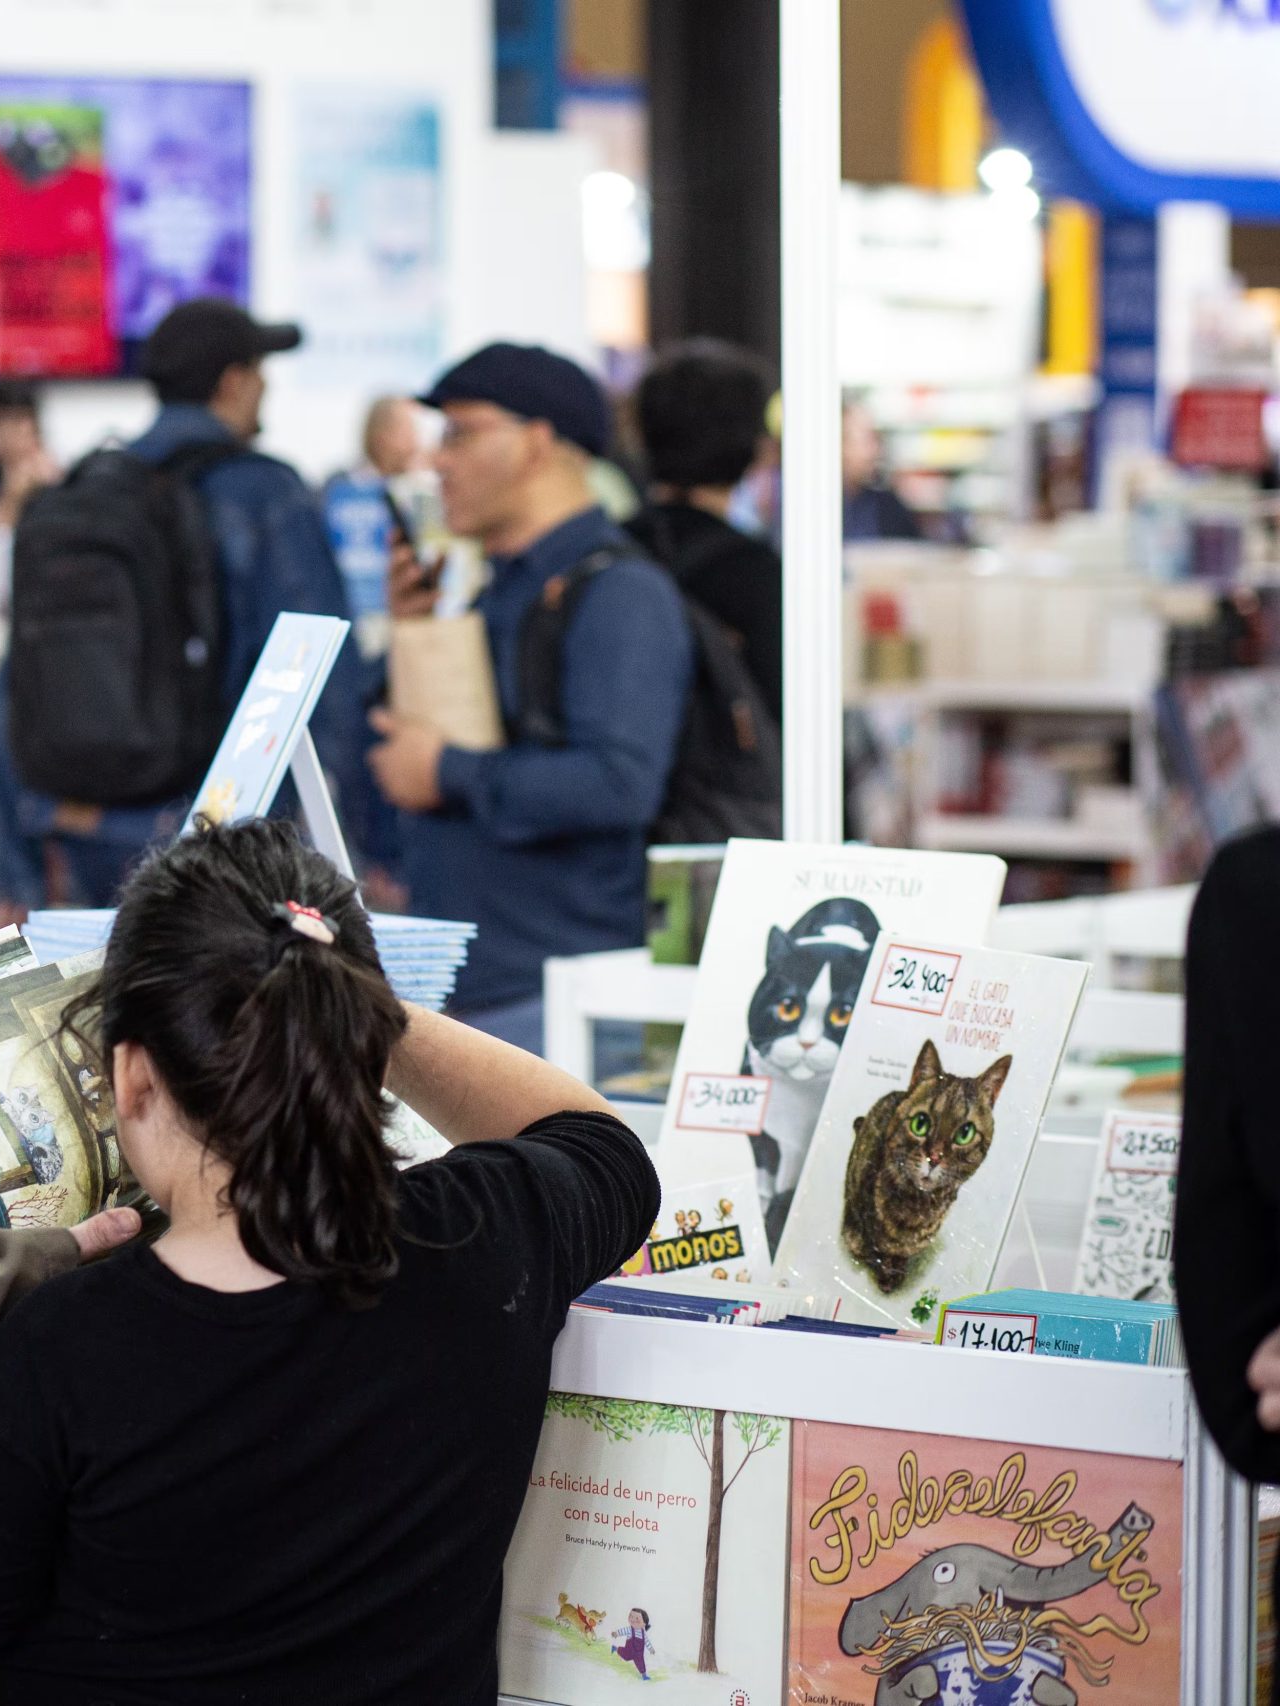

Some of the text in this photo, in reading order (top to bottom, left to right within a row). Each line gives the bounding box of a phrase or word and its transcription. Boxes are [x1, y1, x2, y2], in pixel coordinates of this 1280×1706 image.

[968, 980, 1008, 1004] EL GATO
[948, 1000, 970, 1022] QUE
[970, 1003, 1014, 1029] BUSCABA
[945, 1023, 1004, 1052] UN NOMBRE
[652, 1230, 740, 1271] monos
[1054, 1339, 1081, 1354] Kling
[528, 1471, 697, 1509] La felicidad de un perro
[564, 1508, 659, 1532] con su pelota
[565, 1533, 585, 1545] Bruce
[585, 1538, 608, 1550] Handy
[613, 1542, 640, 1553] Hyewon
[641, 1545, 657, 1556] Yum
[804, 1692, 828, 1705] Jacob
